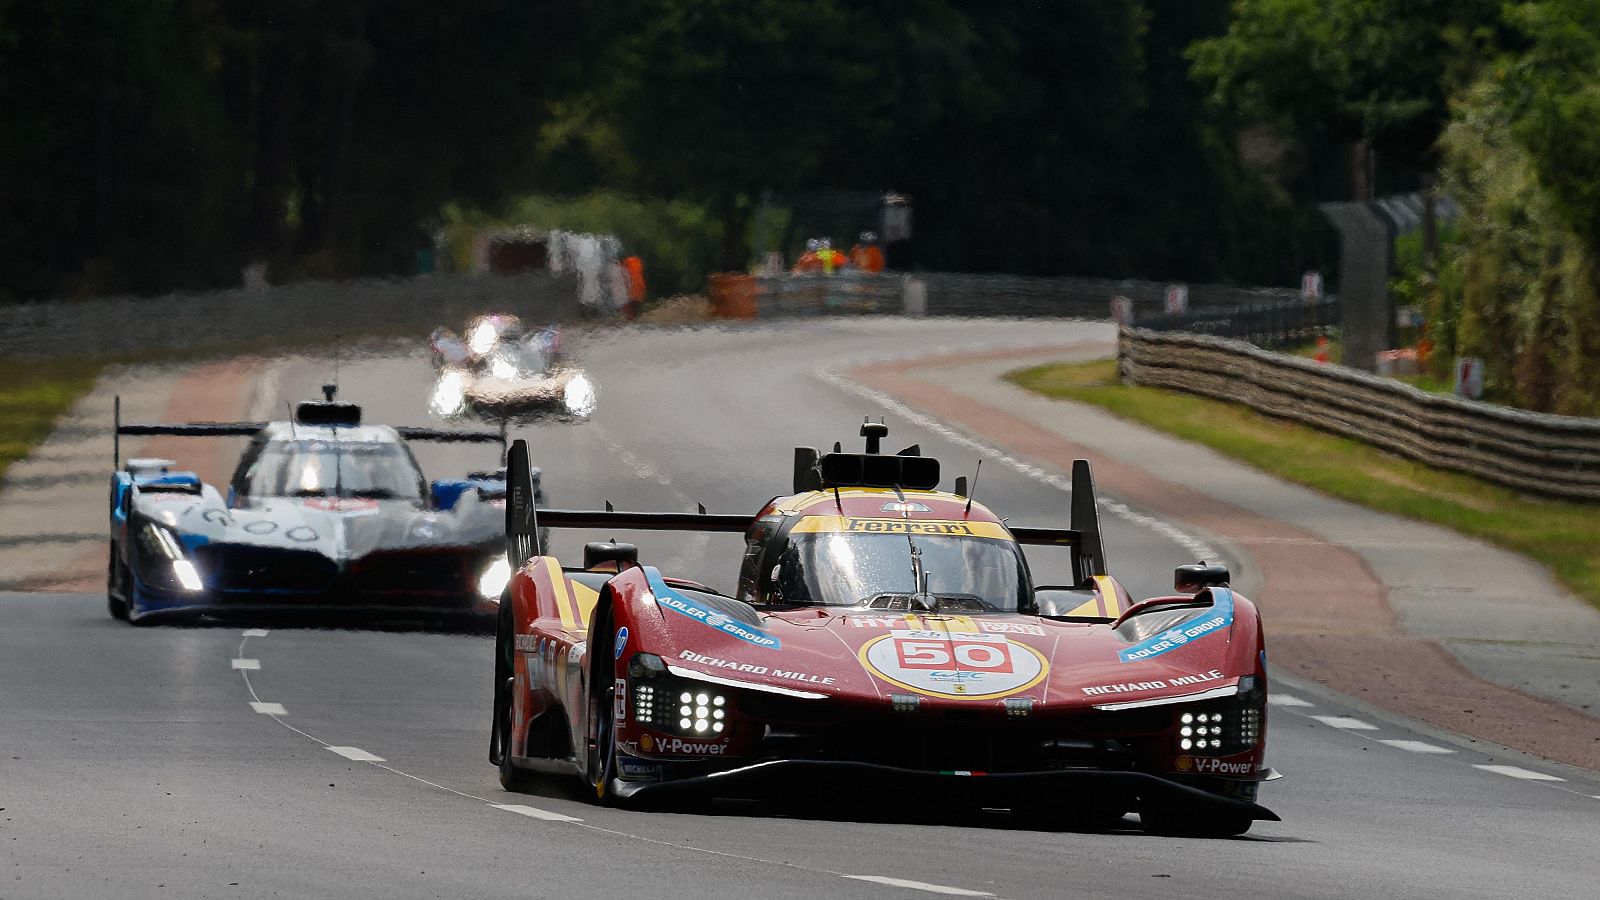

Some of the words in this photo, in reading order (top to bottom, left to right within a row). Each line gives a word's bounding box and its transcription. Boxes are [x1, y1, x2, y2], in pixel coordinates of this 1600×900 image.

[845, 518, 974, 535] Ferrari
[658, 596, 708, 620] ADLER
[723, 623, 775, 646] GROUP
[1127, 640, 1175, 660] ADLER
[1185, 617, 1225, 638] GROUP
[679, 649, 769, 675] RICHARD
[771, 669, 836, 685] MILLE
[900, 641, 1006, 668] 50
[1081, 680, 1167, 696] RICHARD
[1168, 669, 1225, 687] MILLE
[655, 738, 728, 755] V-Power
[1195, 758, 1252, 774] V-Power
